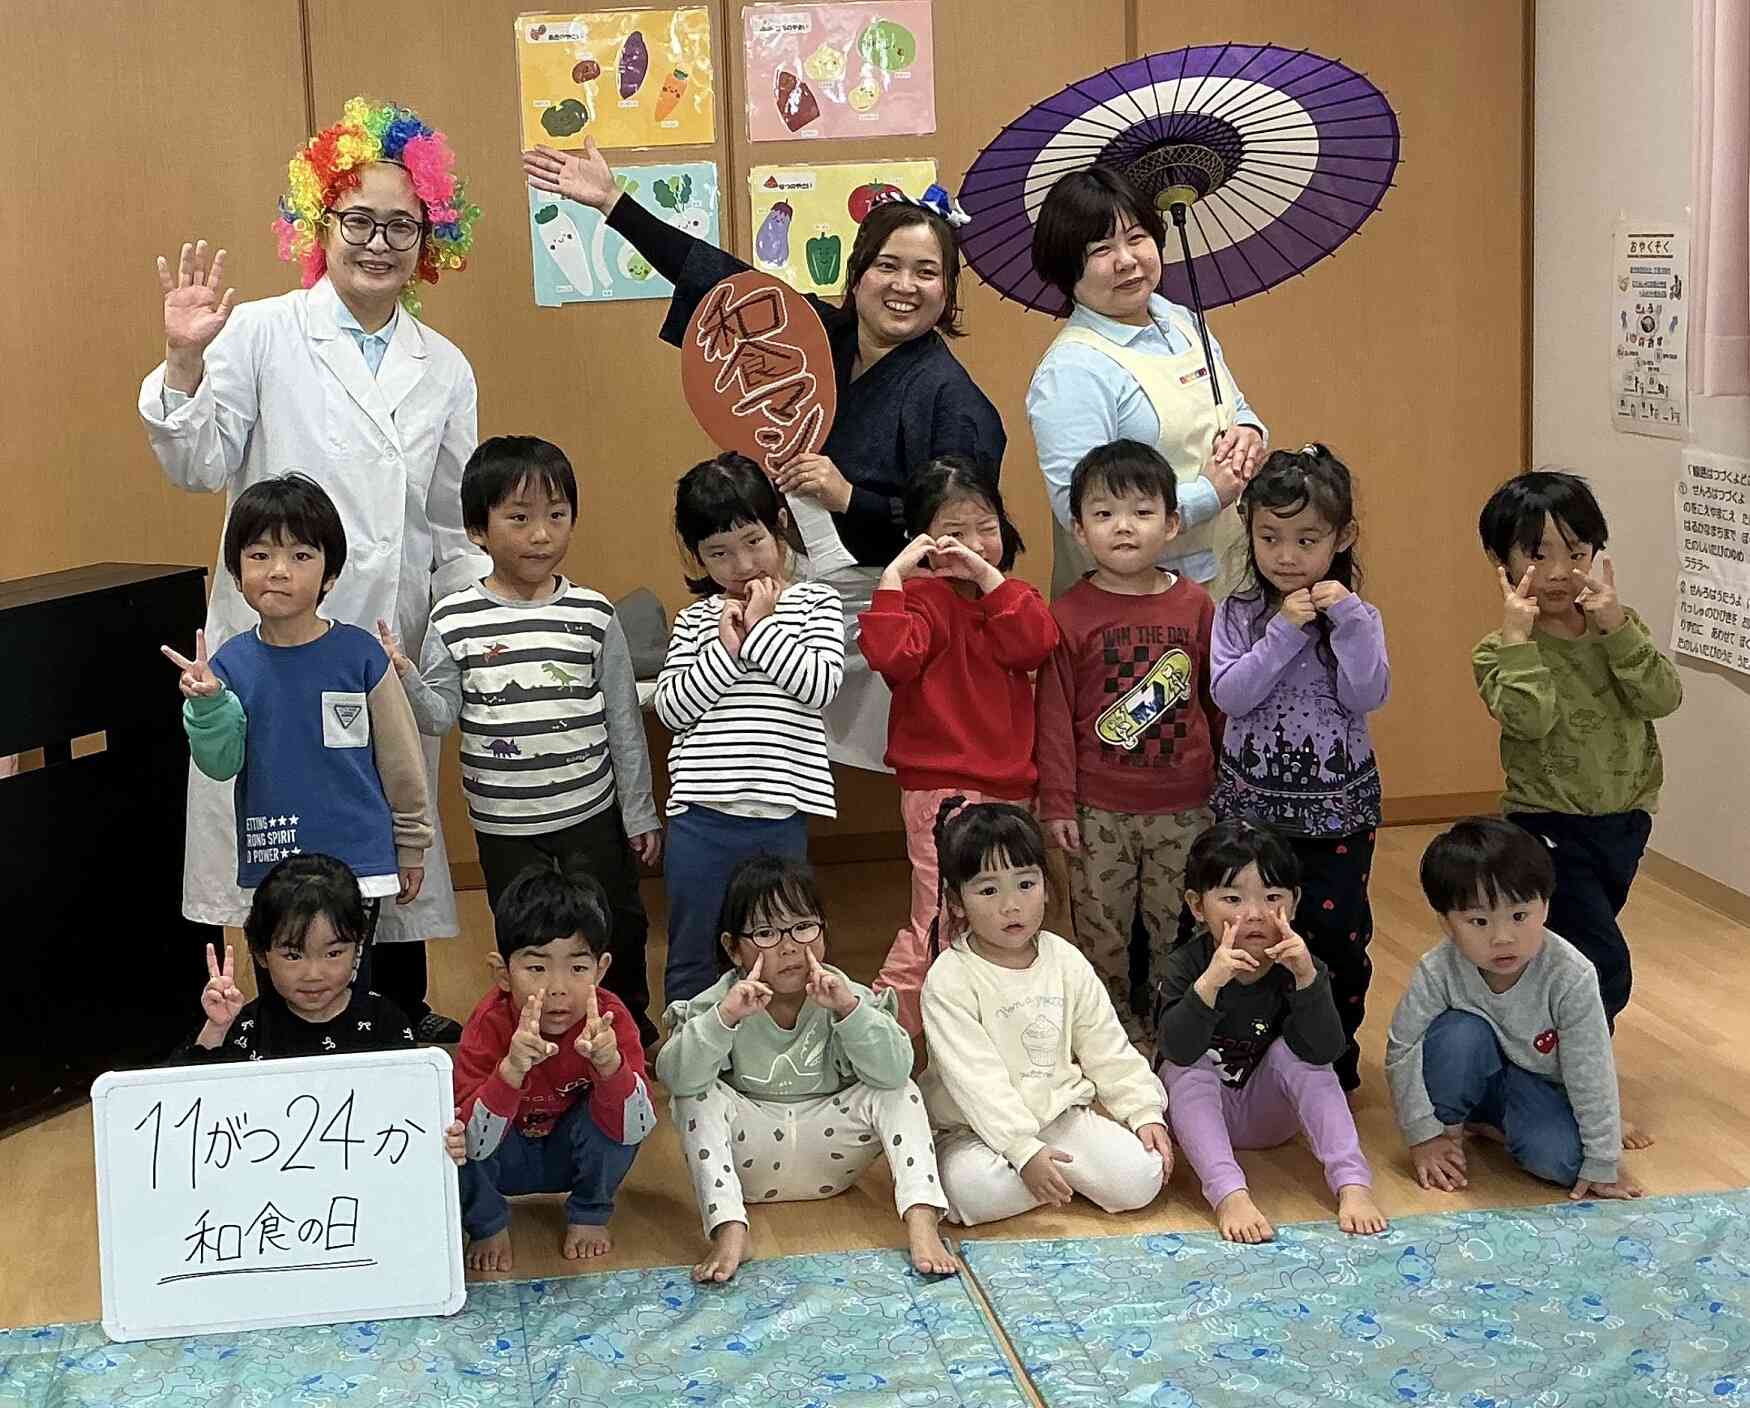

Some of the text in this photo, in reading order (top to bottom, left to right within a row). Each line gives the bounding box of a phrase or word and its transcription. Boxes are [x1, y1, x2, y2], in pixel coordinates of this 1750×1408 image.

[1630, 241, 1670, 254] おやくそく
[1136, 626, 1163, 644] THE
[1168, 626, 1191, 645] DAY
[267, 829, 296, 845] SPIRIT
[253, 848, 279, 863] POWER
[185, 1196, 359, 1264] 和食の日
